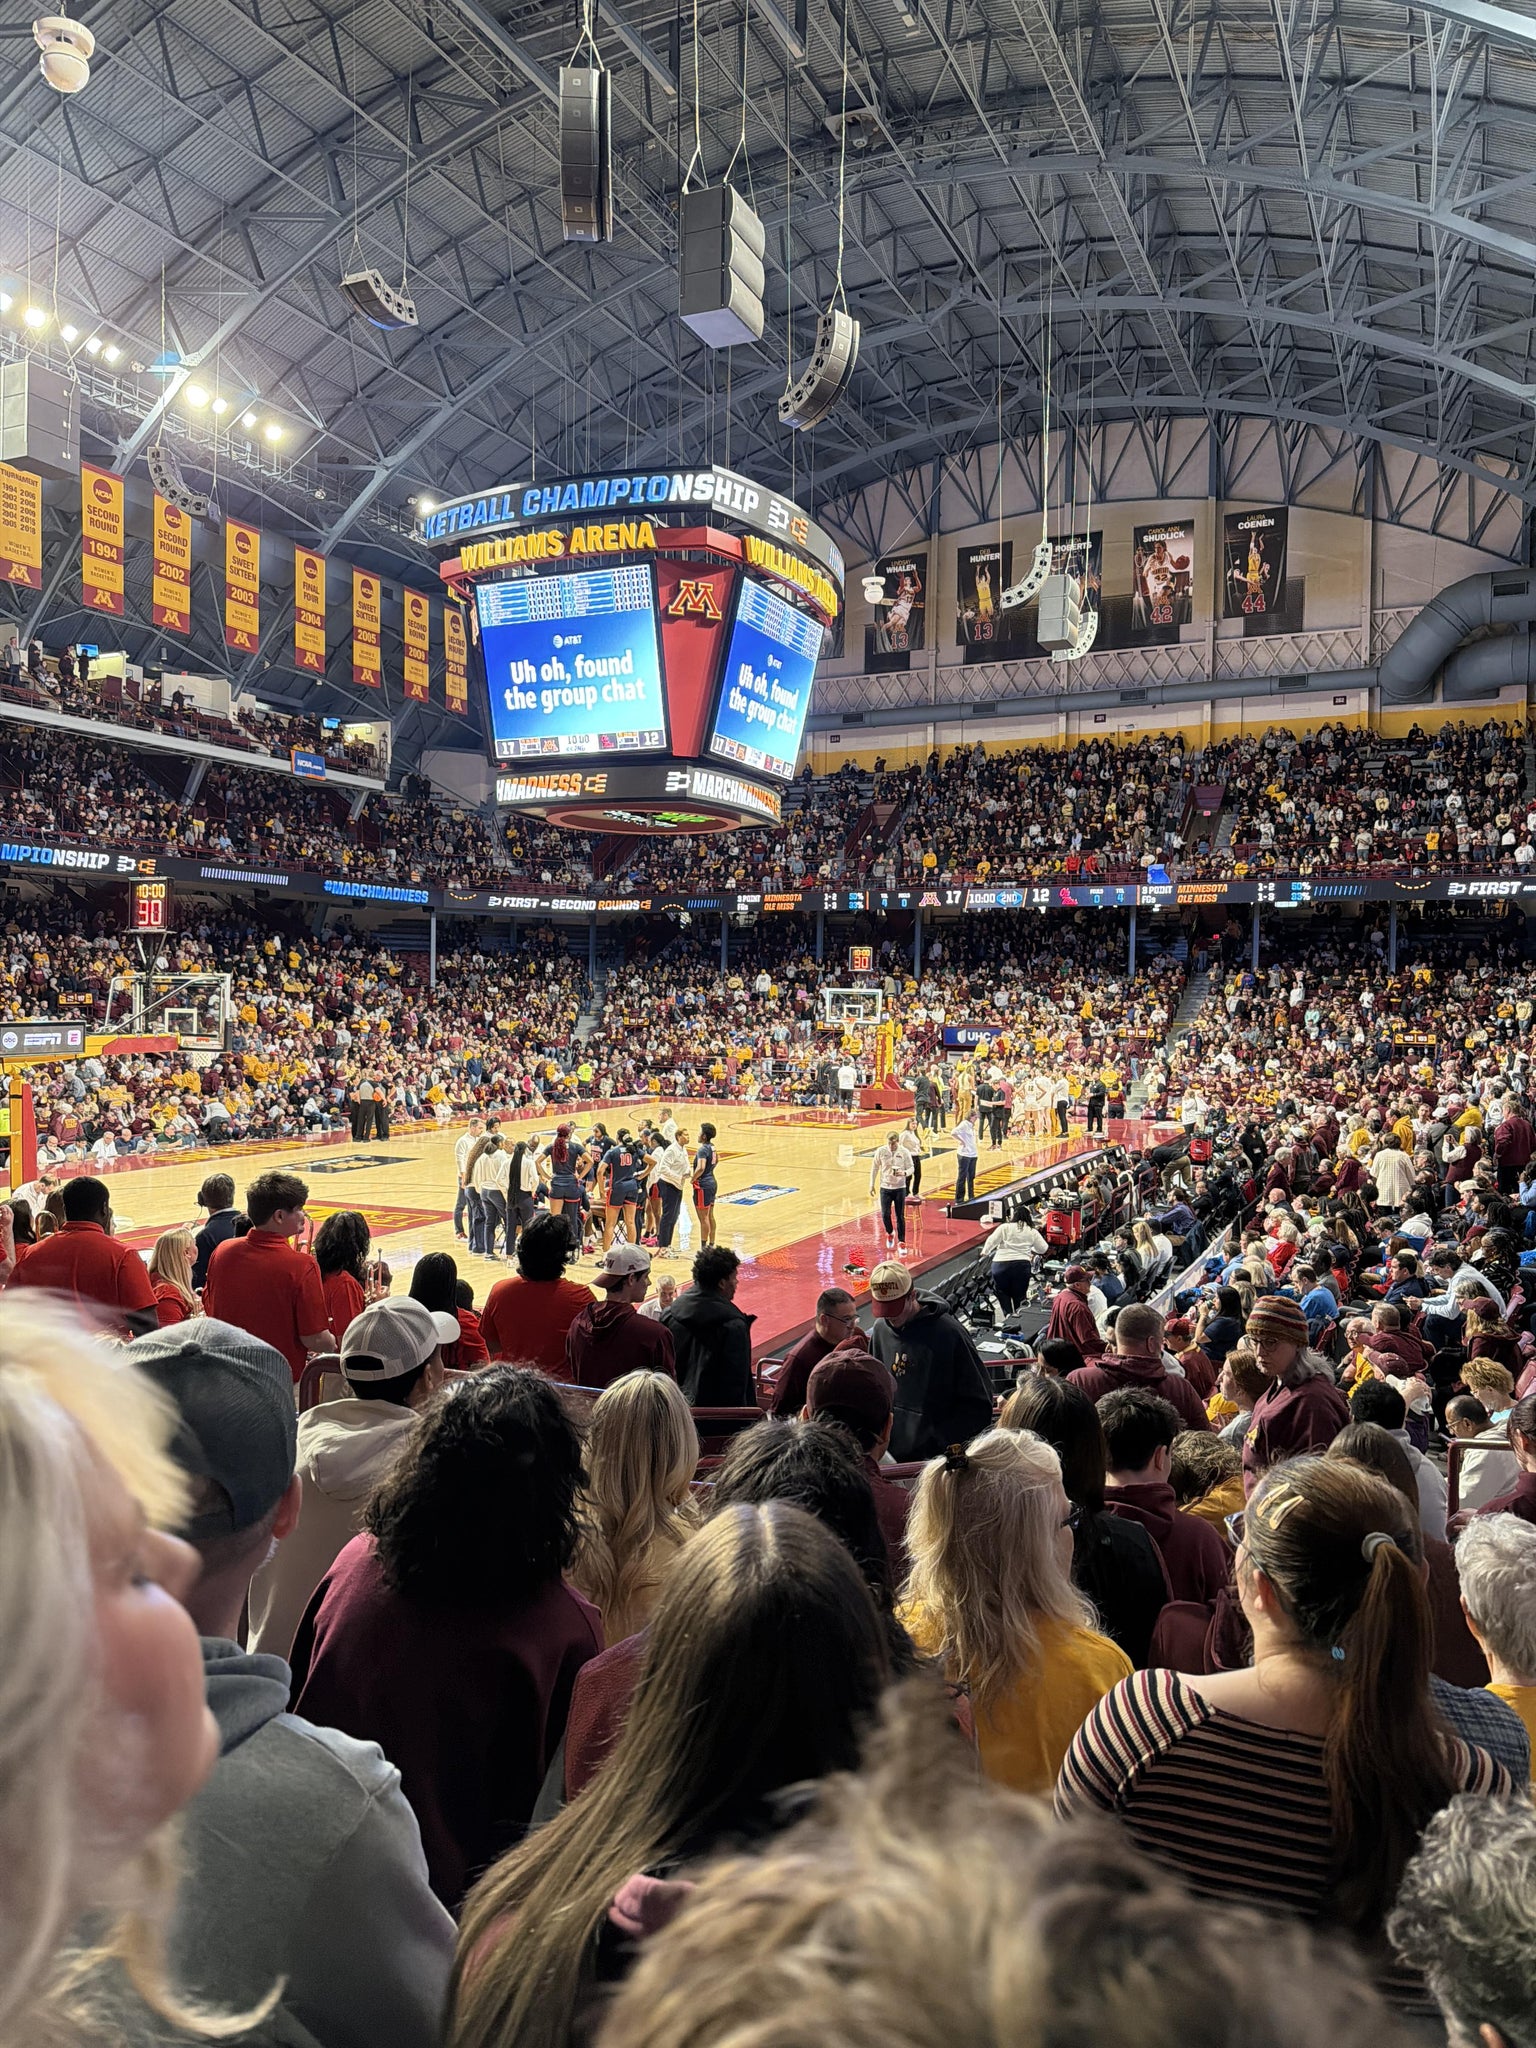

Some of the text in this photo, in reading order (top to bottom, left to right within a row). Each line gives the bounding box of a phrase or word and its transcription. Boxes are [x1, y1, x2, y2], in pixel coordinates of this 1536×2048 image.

[95, 488, 113, 500] NCAA
[522, 473, 759, 517] CHAMPIONSHIP
[87, 504, 120, 523] SECOND
[89, 516, 118, 535] ROUND
[1148, 527, 1166, 535] CAROL
[1238, 518, 1275, 530] COENEN
[158, 529, 187, 548] SECOND
[1143, 530, 1185, 543] SHUDLICK
[89, 540, 118, 560] 1994
[160, 541, 186, 558] ROUND
[460, 521, 657, 572] WILLIAMS ARENA
[1055, 541, 1093, 553] ROBERTS
[232, 555, 255, 571] SWEET
[744, 535, 814, 593] WILLIAMS
[970, 553, 1000, 563] HUNTER
[159, 562, 185, 582] 2002
[229, 565, 257, 583] SIXTEEN
[886, 563, 917, 574] WHALEN
[302, 581, 319, 595] FINAL
[231, 587, 254, 604] 2003
[303, 592, 319, 604] FOUR
[358, 601, 377, 614] SWEET
[1242, 594, 1265, 613] 44
[300, 610, 321, 627] 2004
[356, 609, 379, 625] SIXTEEN
[1150, 606, 1173, 624] 42
[407, 619, 427, 633] SECOND
[974, 623, 993, 640] 13
[357, 629, 377, 644] 2005
[564, 634, 582, 645] AT&T
[891, 633, 909, 649] 13
[510, 649, 633, 685] Uh oh, found
[739, 663, 799, 711] Uh oh, found
[504, 678, 645, 714] the group chat
[729, 687, 797, 735] the group chat
[643, 732, 660, 745] 12
[714, 738, 724, 751] 17
[502, 741, 515, 755] 17
[0, 843, 110, 869] MPIONSHIP
[323, 879, 429, 904] #MARCHMADNESS
[1032, 888, 1049, 902] 12
[1177, 884, 1228, 894] MINNESOTA
[1468, 881, 1522, 895] FIRST
[502, 897, 538, 909] FIRST
[551, 899, 597, 911] SECOND
[598, 900, 640, 911] ROUNDS
[763, 894, 802, 902] MINNESOTA
[881, 898, 888, 908] 4
[901, 898, 907, 908] 0
[945, 890, 961, 904] 17
[969, 893, 995, 904] 10:00
[1001, 894, 1017, 902] 2ND
[1093, 893, 1125, 904] 0 4
[1177, 894, 1193, 904] OLE
[1194, 894, 1217, 903] MISS
[137, 899, 162, 926] 30
[764, 902, 776, 911] OLE
[776, 902, 794, 911] MISS
[854, 957, 868, 968] 30
[23, 1032, 62, 1046] ESPN
[967, 1031, 991, 1041] UHC
[620, 1153, 632, 1166] 10
